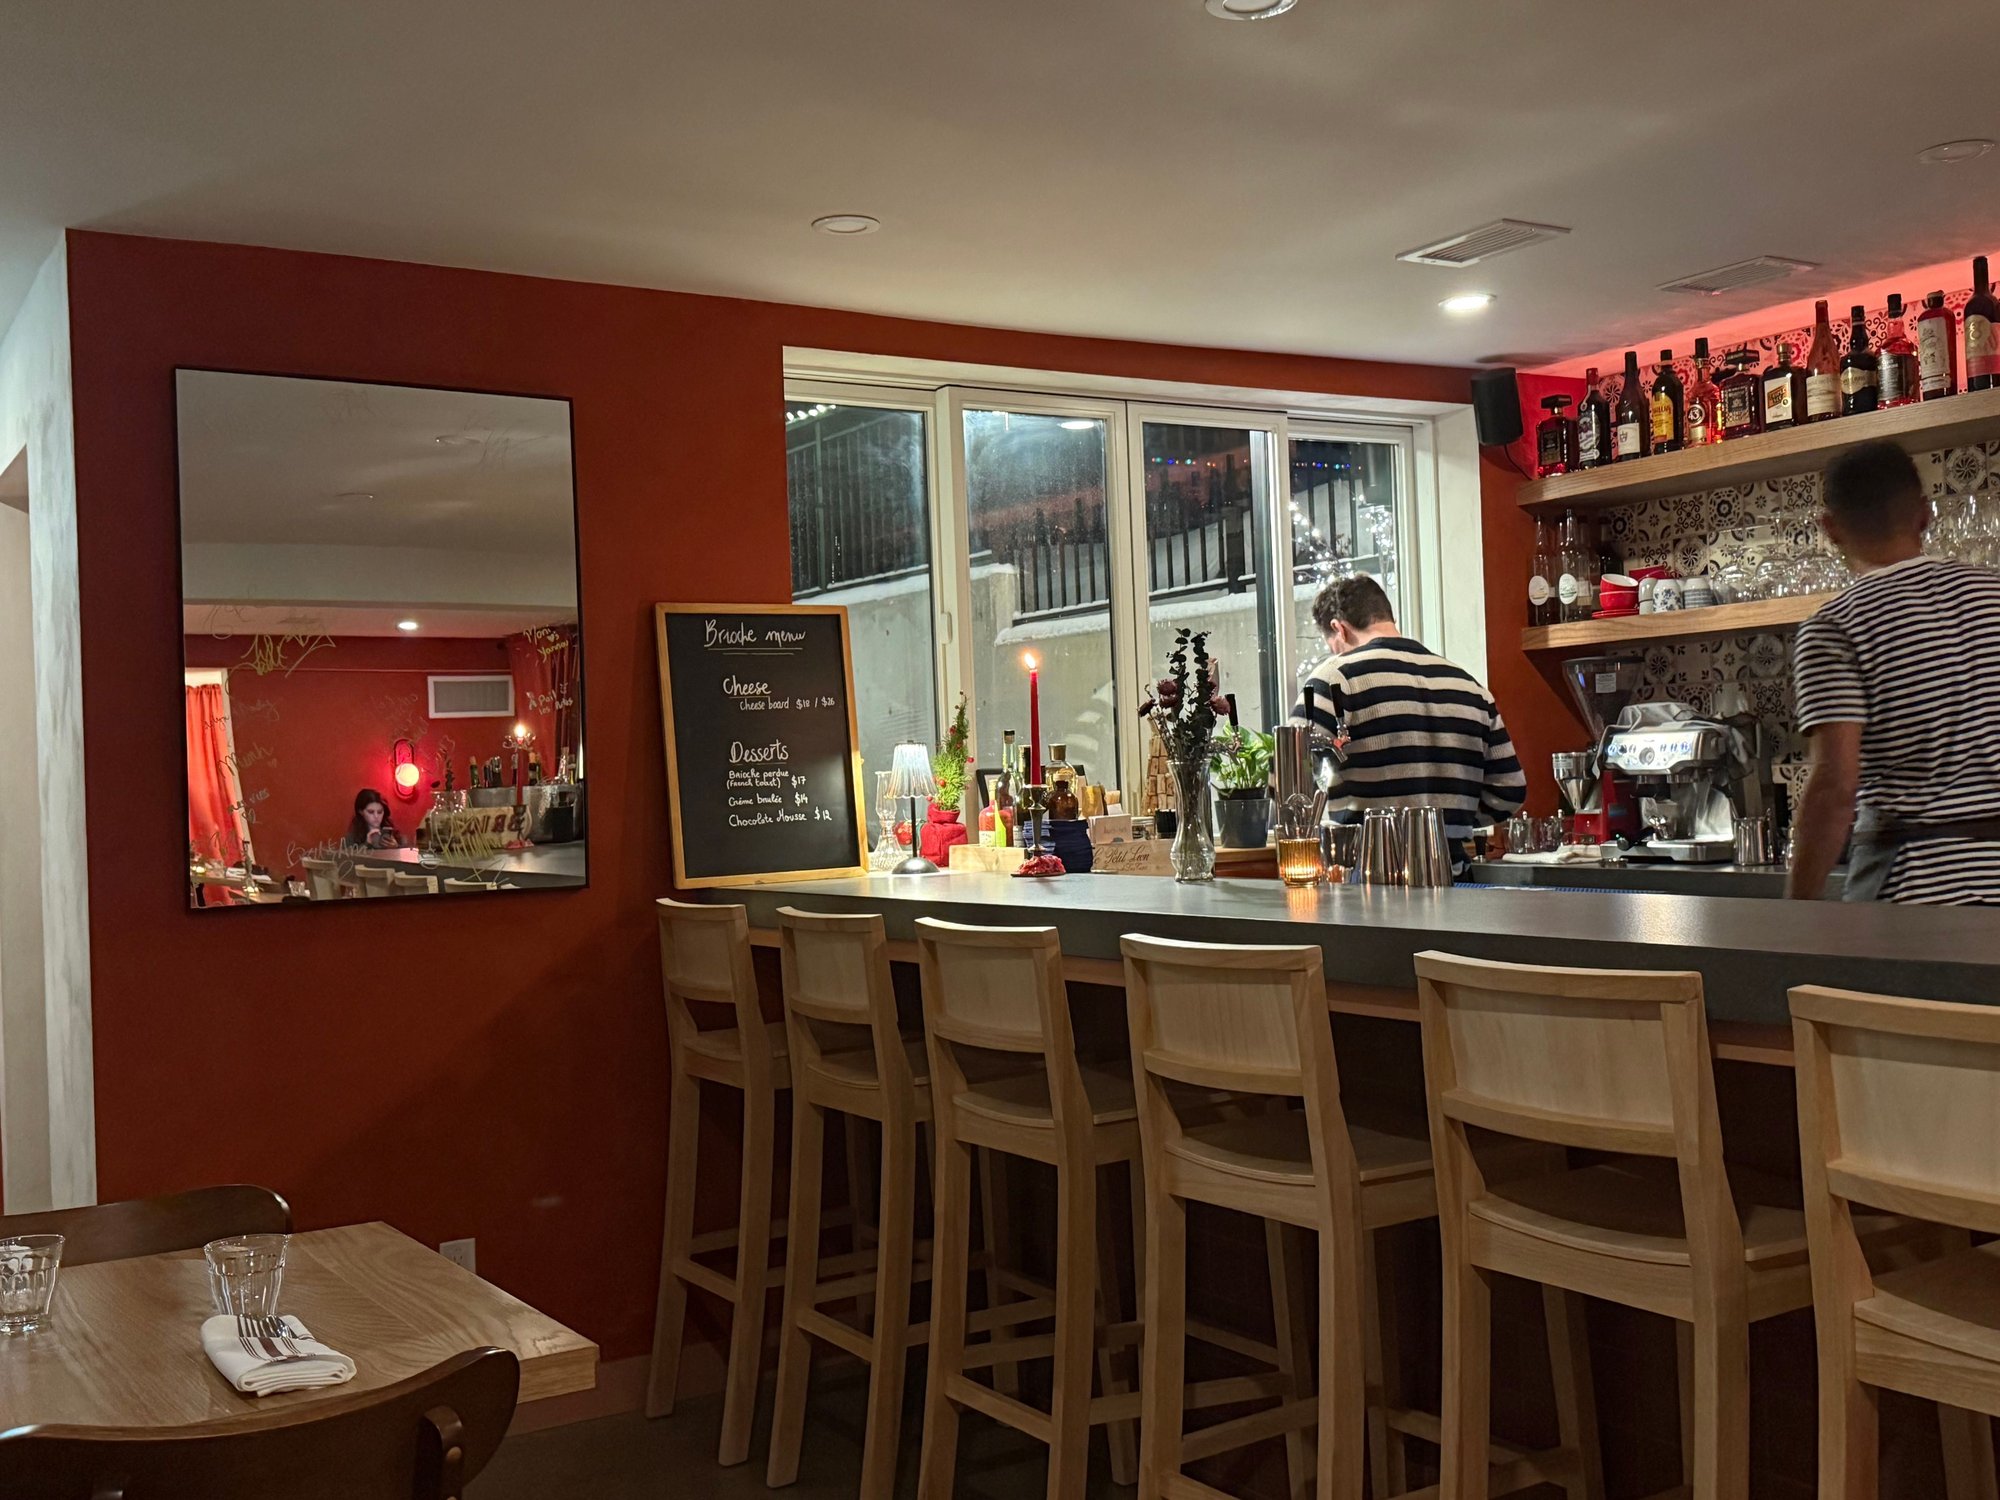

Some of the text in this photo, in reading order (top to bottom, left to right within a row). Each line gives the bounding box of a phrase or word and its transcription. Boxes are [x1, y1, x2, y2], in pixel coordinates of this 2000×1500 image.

[704, 619, 806, 647] Brioche menu
[723, 675, 772, 696] Cheese
[767, 696, 790, 709] board
[814, 697, 819, 708] /
[729, 739, 789, 763] Desserts
[755, 778, 781, 789] toast)
[791, 775, 806, 789] $17
[762, 768, 789, 783] perdue
[795, 792, 808, 806] $14
[728, 812, 774, 827] Chocolate
[776, 808, 808, 822] Mousse
